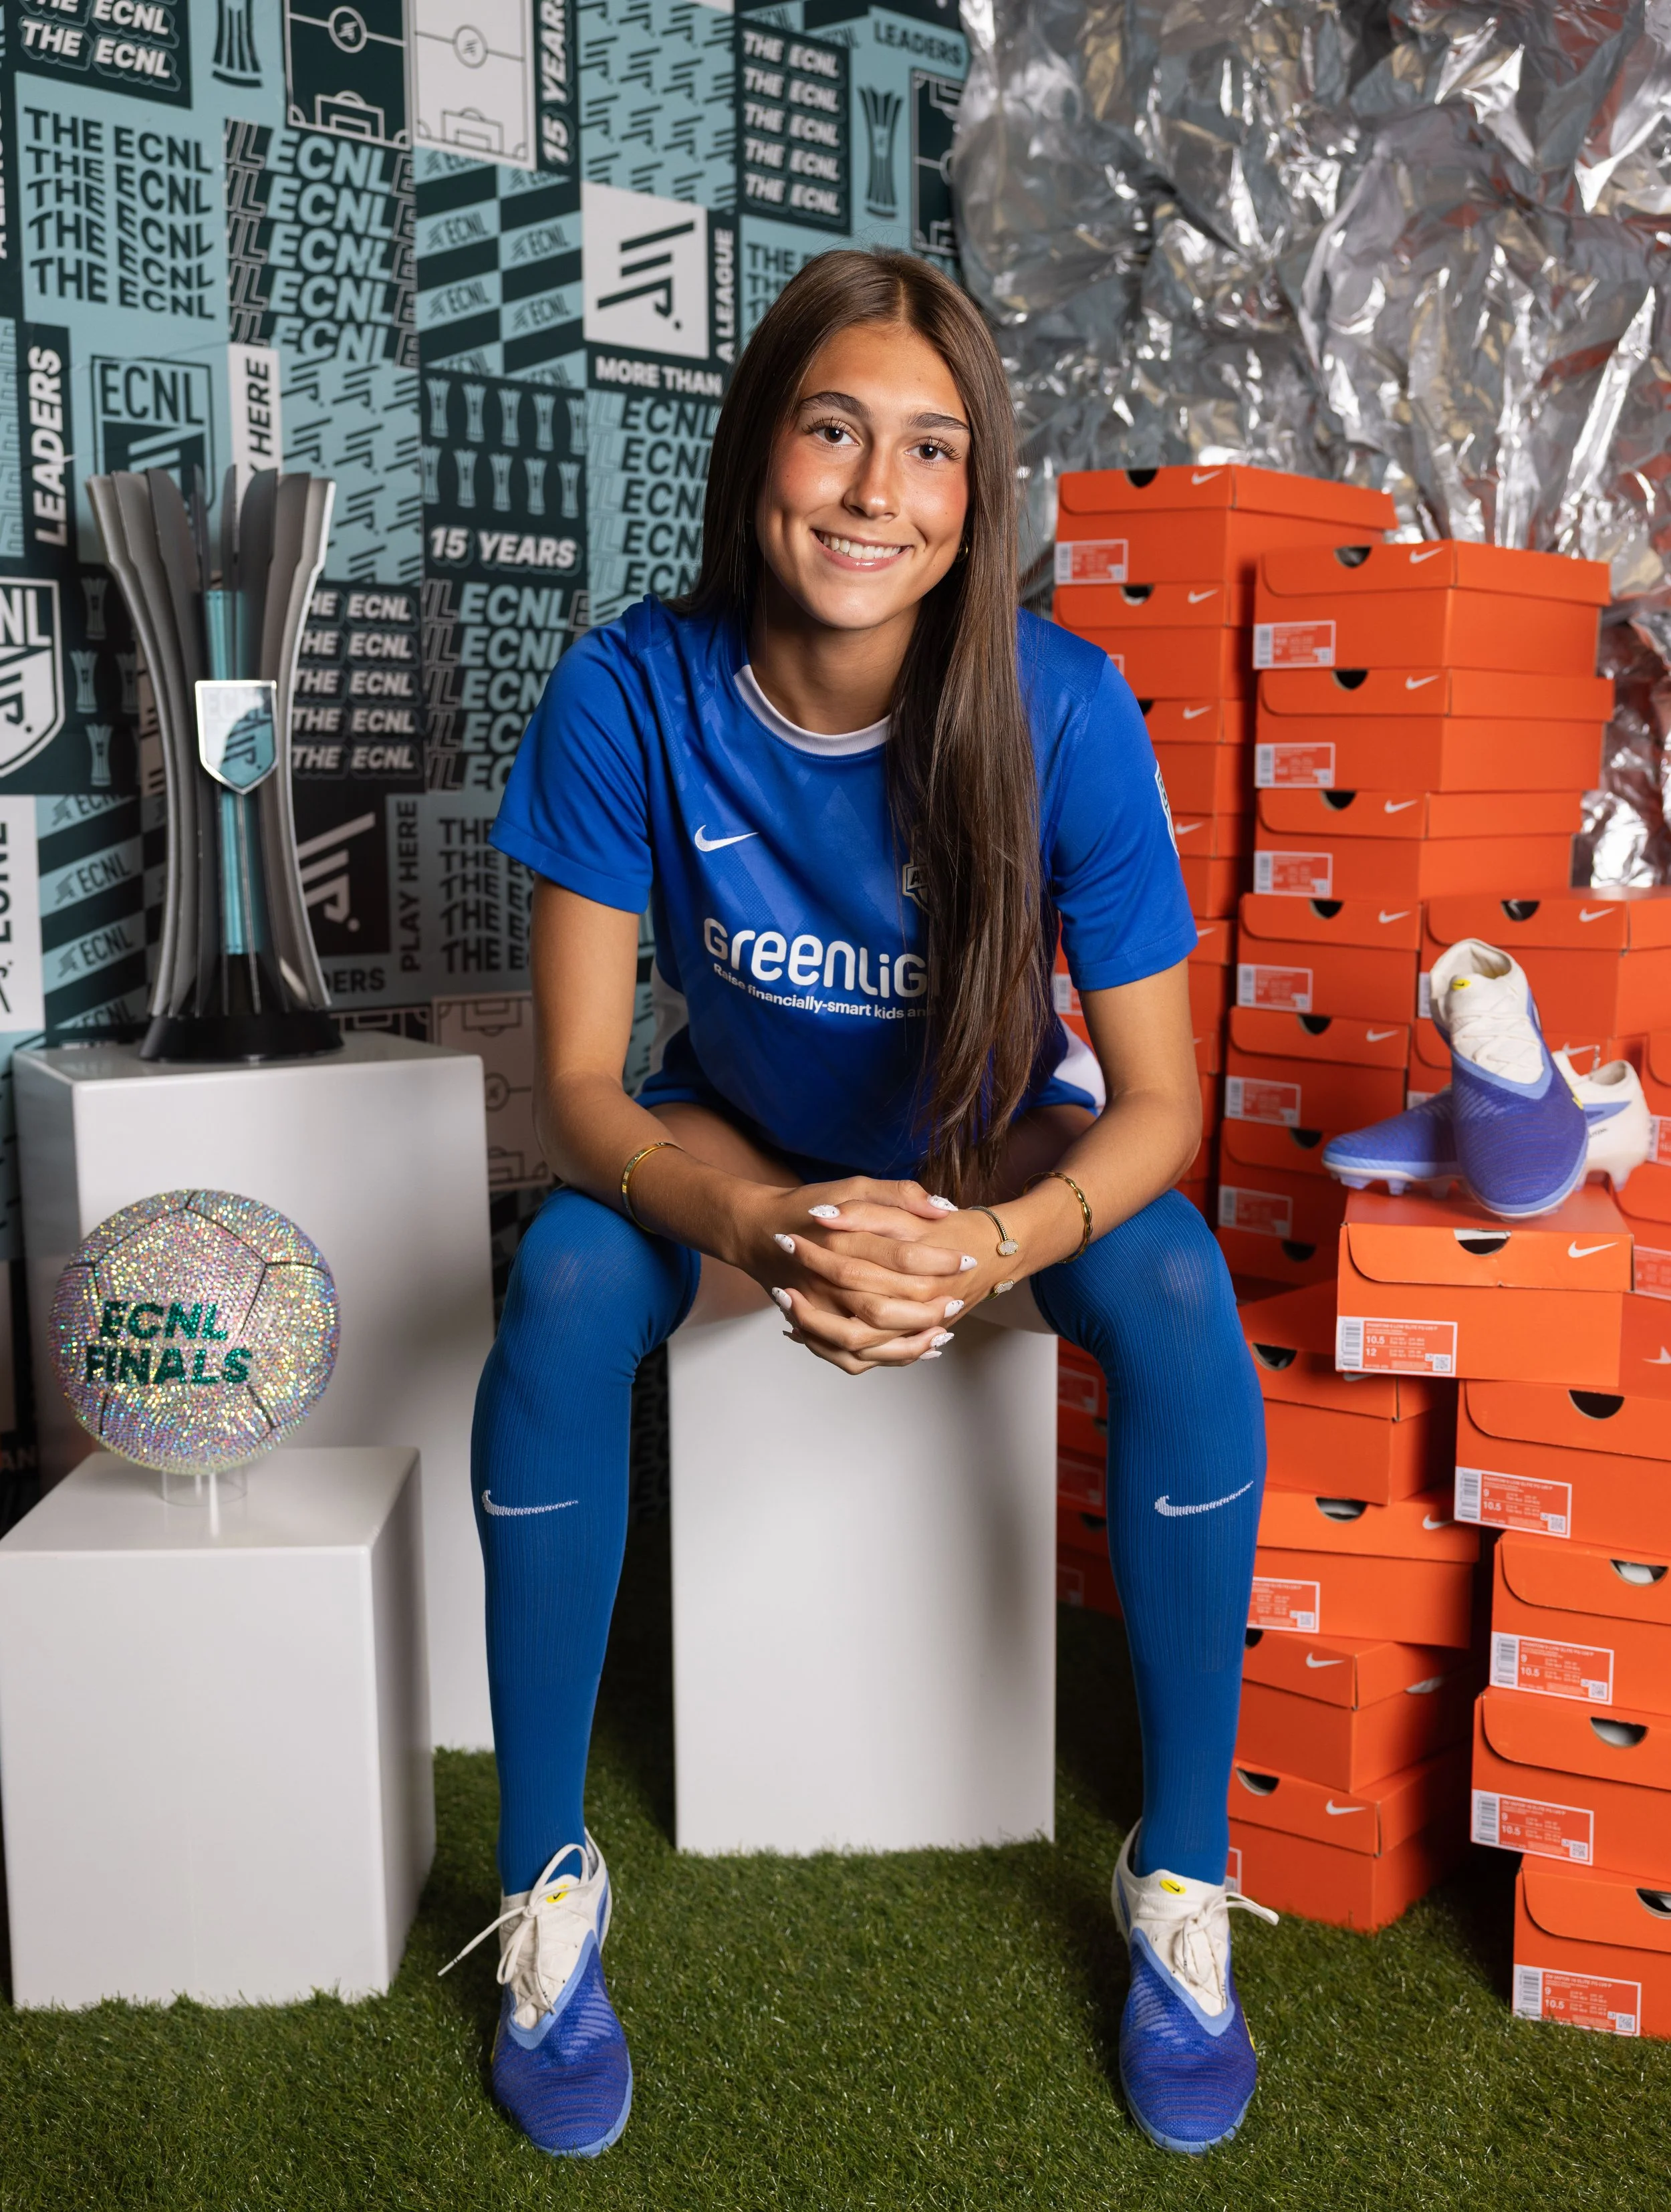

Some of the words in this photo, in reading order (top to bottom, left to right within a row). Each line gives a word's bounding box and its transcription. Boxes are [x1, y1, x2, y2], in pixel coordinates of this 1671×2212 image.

[92, 0, 168, 35] ECNL
[21, 19, 83, 57] THE
[94, 37, 171, 78] ECNL
[540, 0, 567, 102] YEAR
[743, 31, 784, 62] THE
[788, 43, 839, 78] ECNL
[873, 21, 962, 67] LEADERS
[743, 66, 784, 98] THE
[789, 79, 840, 113] ECNL
[24, 106, 104, 154] THE
[114, 125, 213, 175] ECNL
[541, 114, 568, 164] 15
[744, 102, 785, 132] THE
[789, 114, 840, 148] ECNL
[265, 129, 392, 195] ECNL
[744, 136, 785, 168] THE
[789, 148, 840, 182] ECNL
[25, 146, 105, 184] THE
[115, 164, 213, 216] ECNL
[745, 172, 785, 203] THE
[789, 183, 840, 216] ECNL
[27, 178, 106, 219] THE
[117, 200, 215, 260] ECNL
[266, 174, 393, 239] ECNL
[444, 211, 490, 244] ECNL
[28, 210, 106, 259] THE
[118, 235, 215, 291] ECNL
[267, 221, 393, 281] ECNL
[527, 223, 571, 258] ECNL
[746, 241, 796, 275] THE
[30, 257, 108, 304] THE
[119, 275, 216, 320] ECNL
[268, 268, 394, 325] ECNL
[446, 279, 491, 314] ECNL
[715, 228, 734, 337] LEAGUE
[529, 293, 571, 326] ECNL
[100, 362, 205, 425] ECNL
[596, 356, 660, 388] MORE
[662, 366, 723, 397] THAN
[245, 358, 272, 457] HERE
[28, 346, 67, 546] LEADERS
[621, 478, 706, 519] ECN
[430, 525, 467, 558] 15
[479, 531, 577, 568] YEARS
[622, 520, 704, 560] ECN
[310, 590, 338, 616] HE
[347, 592, 412, 620] ECNL
[459, 582, 568, 630] ECNL
[301, 629, 340, 656] HE
[348, 631, 412, 659] ECNL
[350, 670, 414, 697] ECNL
[460, 669, 549, 713] ECN
[293, 707, 342, 731] THE
[351, 708, 415, 733] ECNL
[293, 744, 342, 769] THE
[351, 745, 414, 769] ECNL
[398, 800, 418, 882] HERE
[439, 850, 499, 872] THE
[76, 851, 131, 894] ECNL
[440, 872, 499, 900] THE
[399, 890, 421, 972] PLAY
[440, 899, 500, 936] THE
[79, 924, 135, 967] ECNL
[441, 938, 501, 974] THE
[714, 963, 745, 990] Raise
[747, 984, 871, 1016] financially-smart
[874, 1005, 904, 1020] kids
[100, 1301, 229, 1341] ECNL
[87, 1345, 253, 1386] FINALS
[1366, 1348, 1377, 1357] 12
[1521, 1667, 1540, 1678] 10.5
[1501, 1825, 1521, 1836] 10.5
[1545, 1999, 1565, 2010] 10.5
